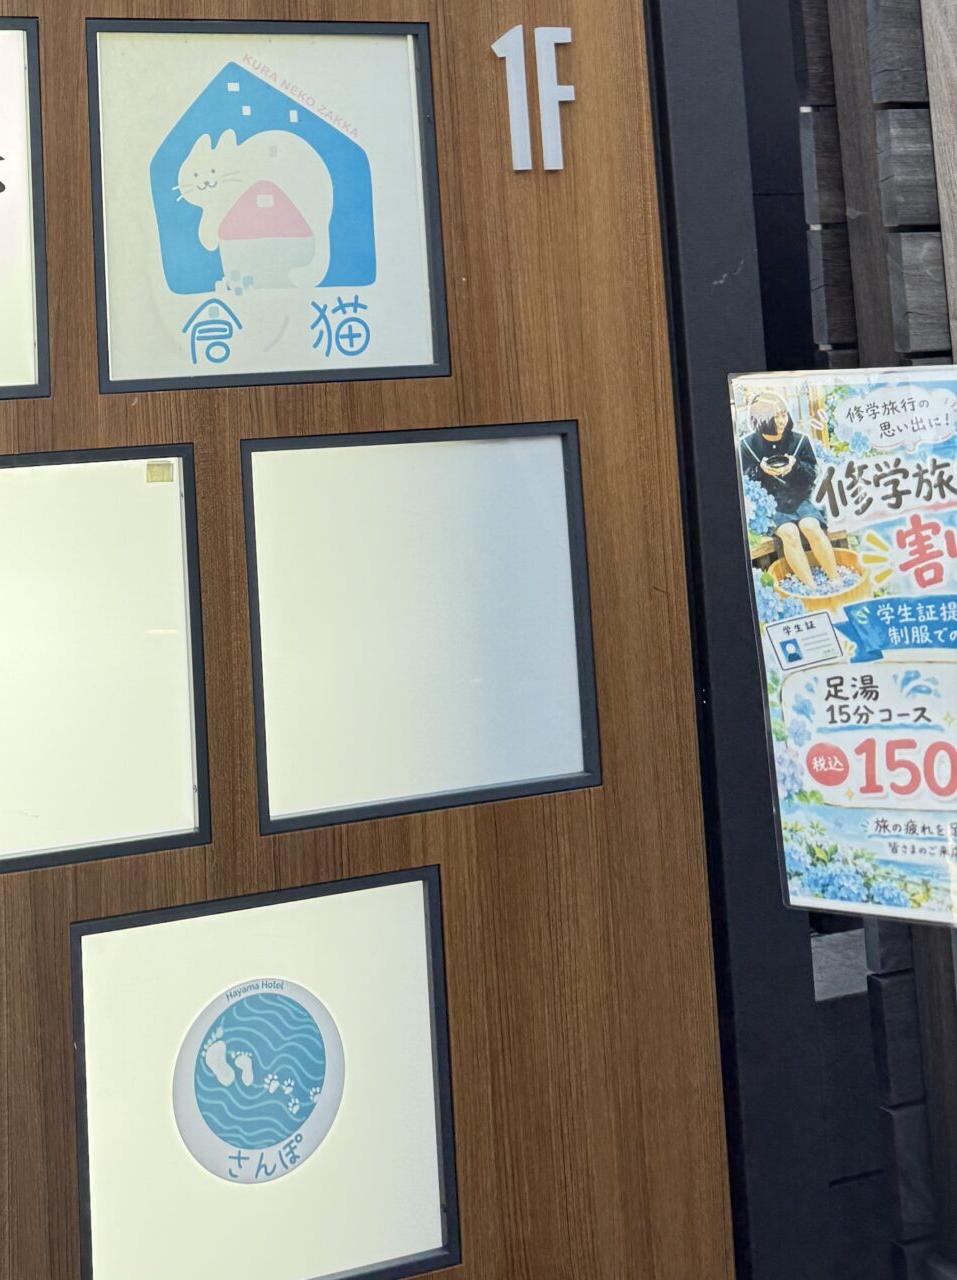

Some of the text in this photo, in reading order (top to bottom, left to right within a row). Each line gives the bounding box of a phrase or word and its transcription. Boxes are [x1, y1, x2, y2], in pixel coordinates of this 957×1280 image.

[242, 53, 359, 138] KURA NEKO ZAKKA
[491, 25, 575, 171] 1F
[846, 397, 929, 423] 修学旅行の
[782, 621, 817, 636] 学生証
[824, 674, 879, 702] 足湯
[827, 705, 932, 725] 15分コース
[225, 980, 284, 1001] Hayama Hotel
[228, 1133, 302, 1179] さんぽ
